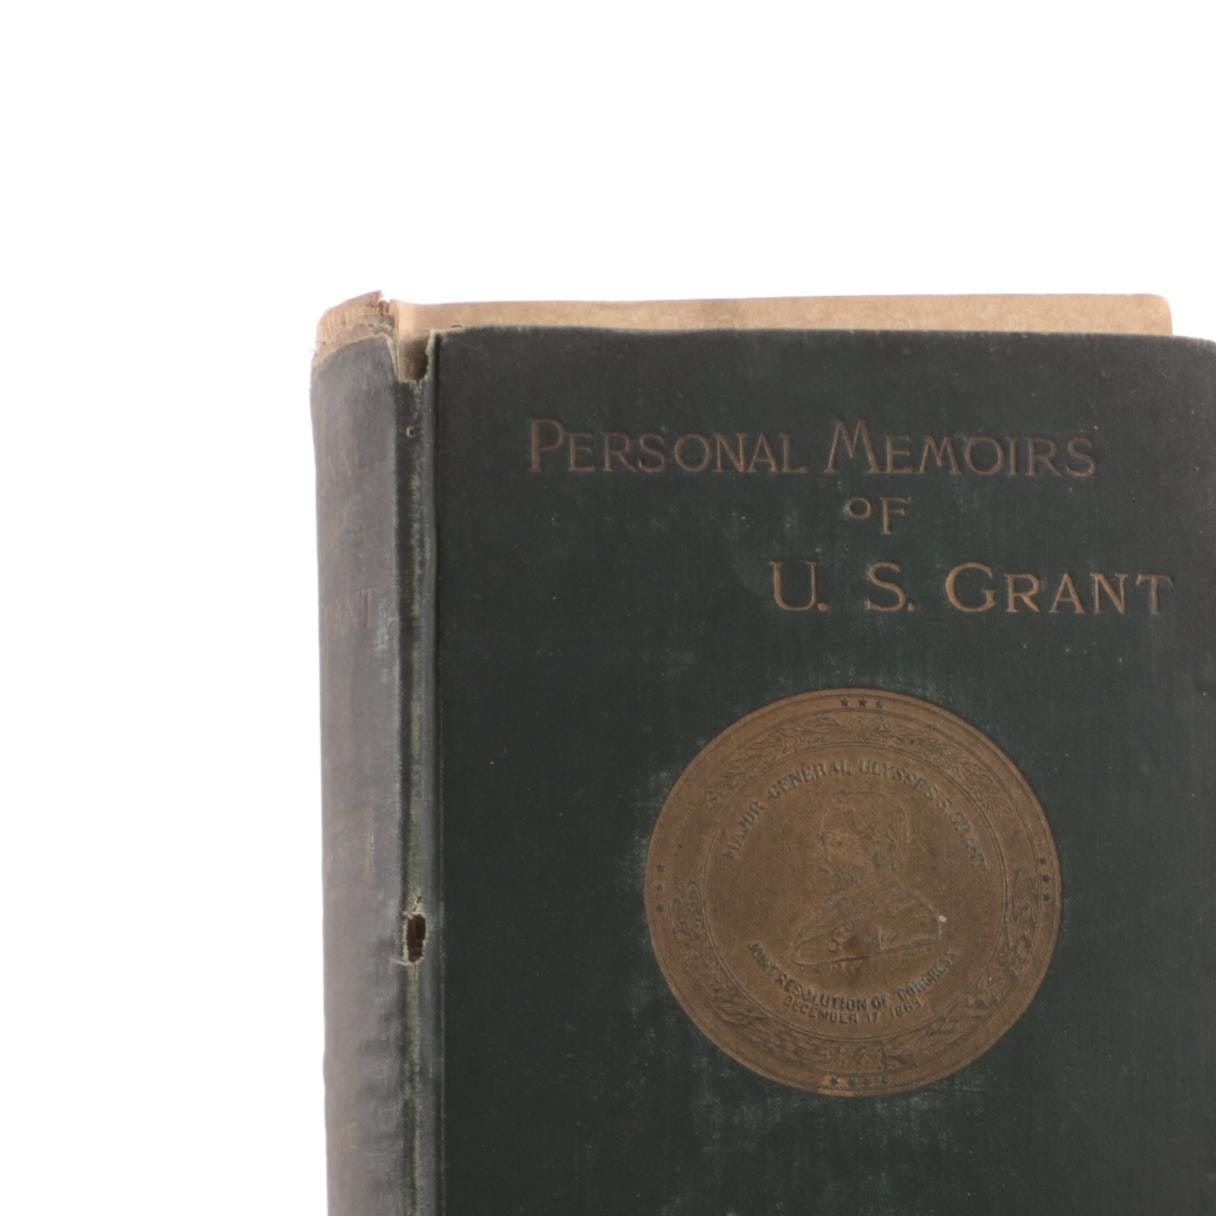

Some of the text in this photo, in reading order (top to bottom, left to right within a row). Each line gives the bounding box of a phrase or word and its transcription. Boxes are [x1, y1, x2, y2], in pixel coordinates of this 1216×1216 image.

[528, 418, 1098, 477] PERSONAL MEMOIRS
[771, 561, 1172, 616] U. S. GRANT
[767, 760, 850, 801] GENERAL
[774, 973, 868, 1012] RESOLUTION
[782, 993, 858, 1025] DECEMBER
